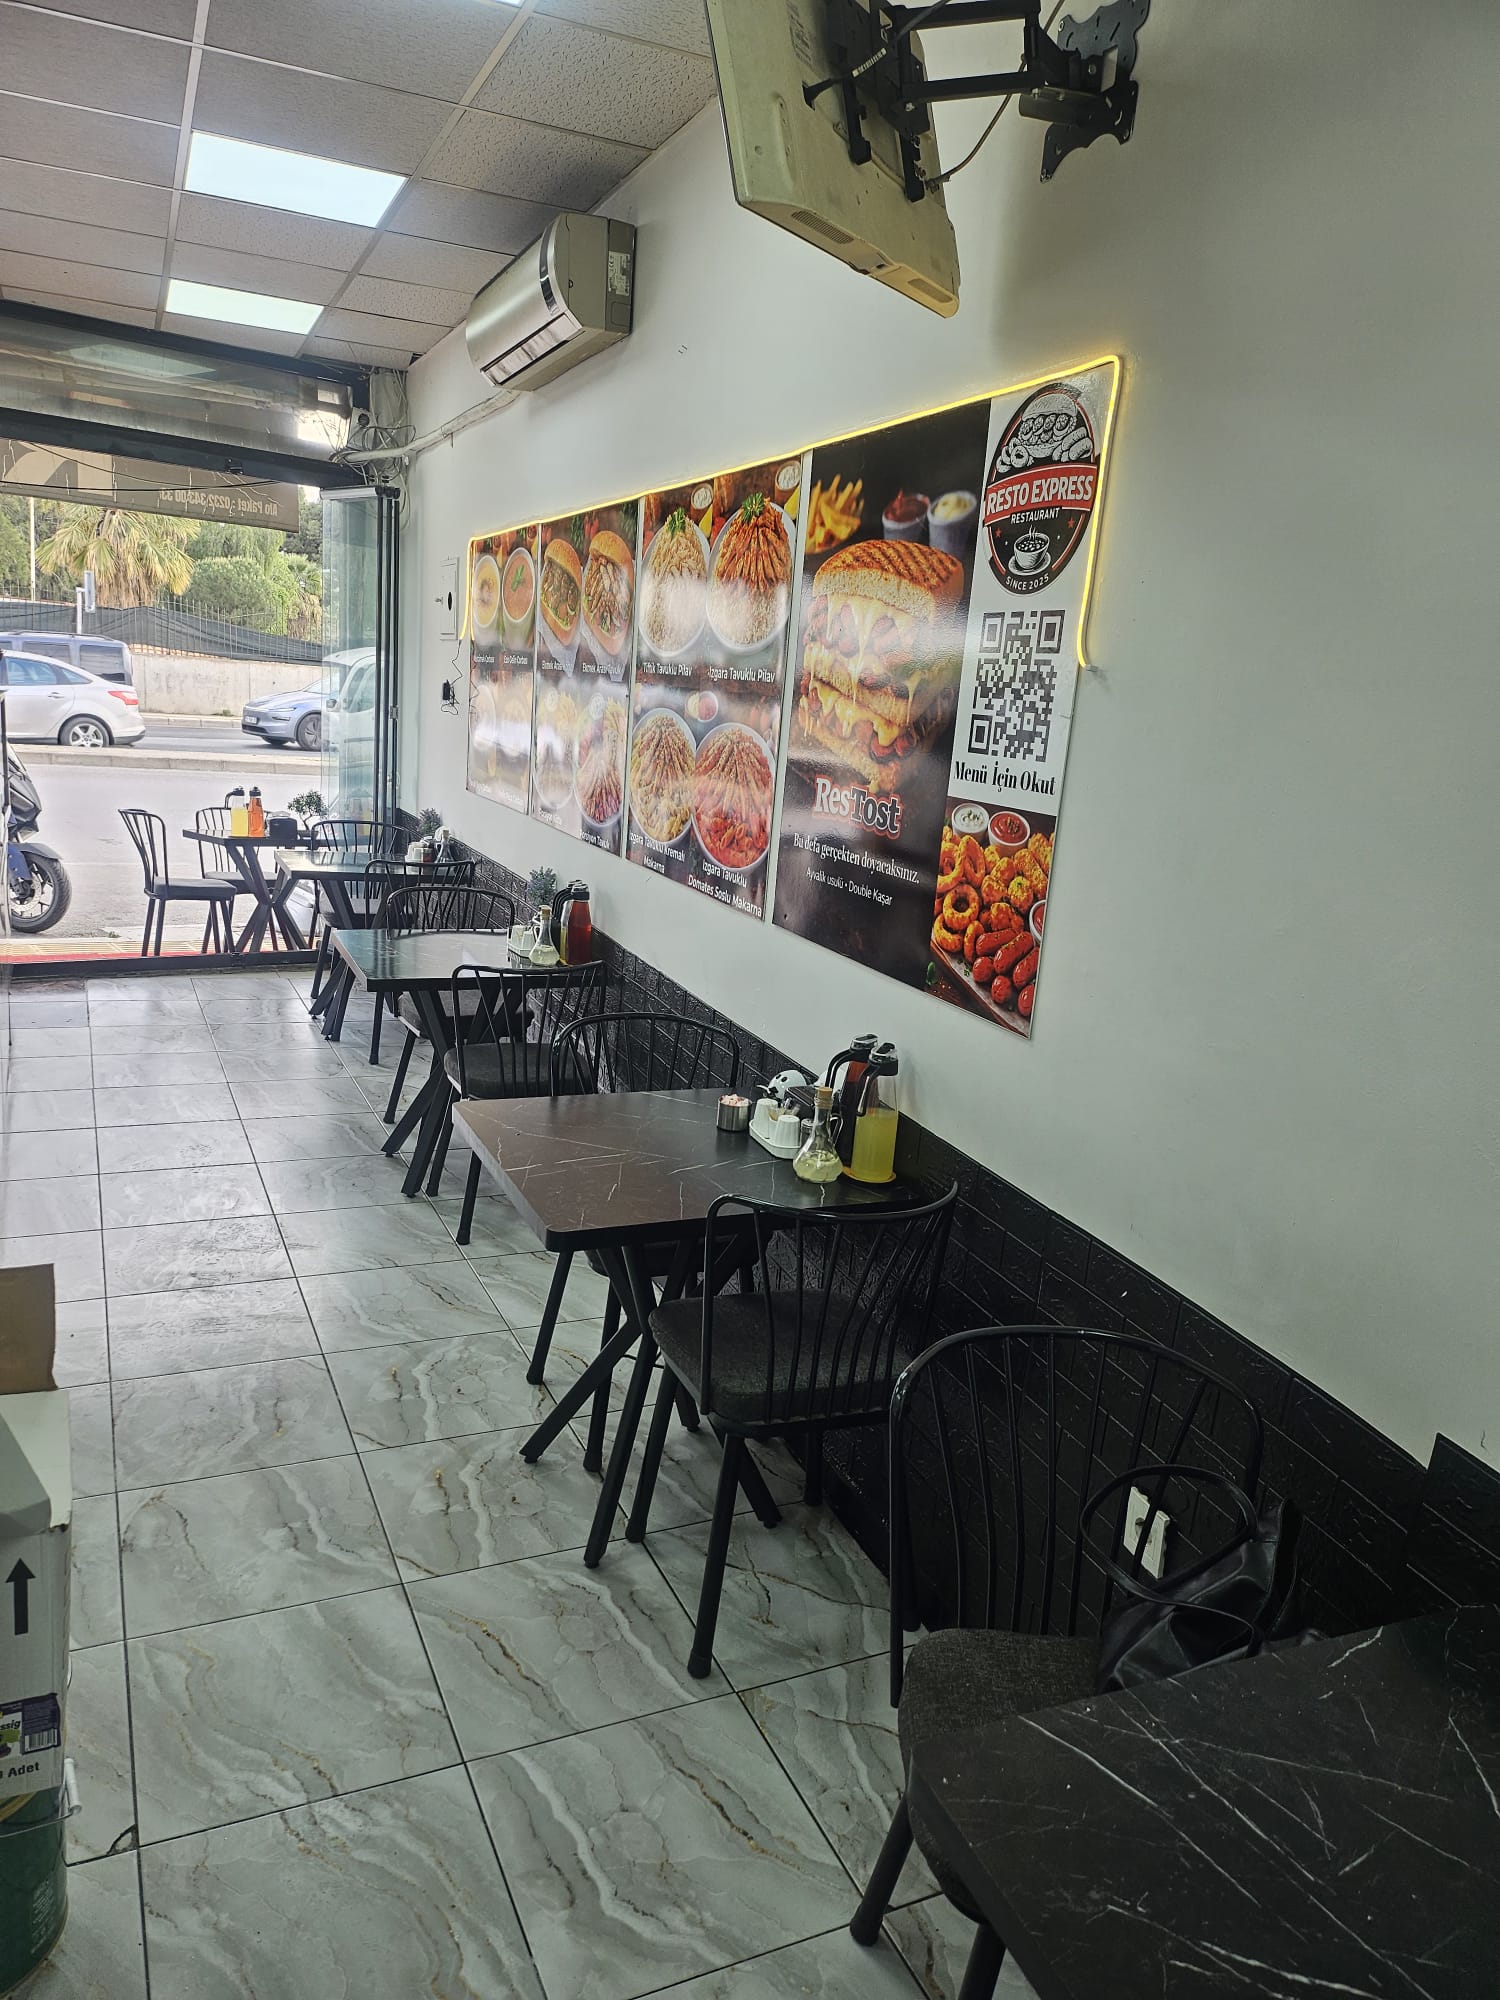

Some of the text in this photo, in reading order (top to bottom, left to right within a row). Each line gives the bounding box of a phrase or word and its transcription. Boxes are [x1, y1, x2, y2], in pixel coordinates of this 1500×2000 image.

[986, 475, 1094, 515] RESTO EXPRESS
[1010, 507, 1060, 525] RESTAURANT
[1005, 574, 1050, 591] SINCE 2025
[677, 664, 693, 677] Pilav
[729, 667, 756, 681] Tavuklu
[757, 668, 776, 683] Pilav
[954, 761, 1056, 795] Menü İçin Okut
[815, 776, 901, 834] ResTost
[793, 832, 920, 884] Bu defa gerçekten doyacaksınız.
[721, 866, 748, 889] Tavuklu
[687, 874, 762, 917] Domates Soslu Makarna
[848, 880, 872, 899] Double
[873, 887, 893, 906] Kaşar
[8, 1762, 40, 1778] Adet
